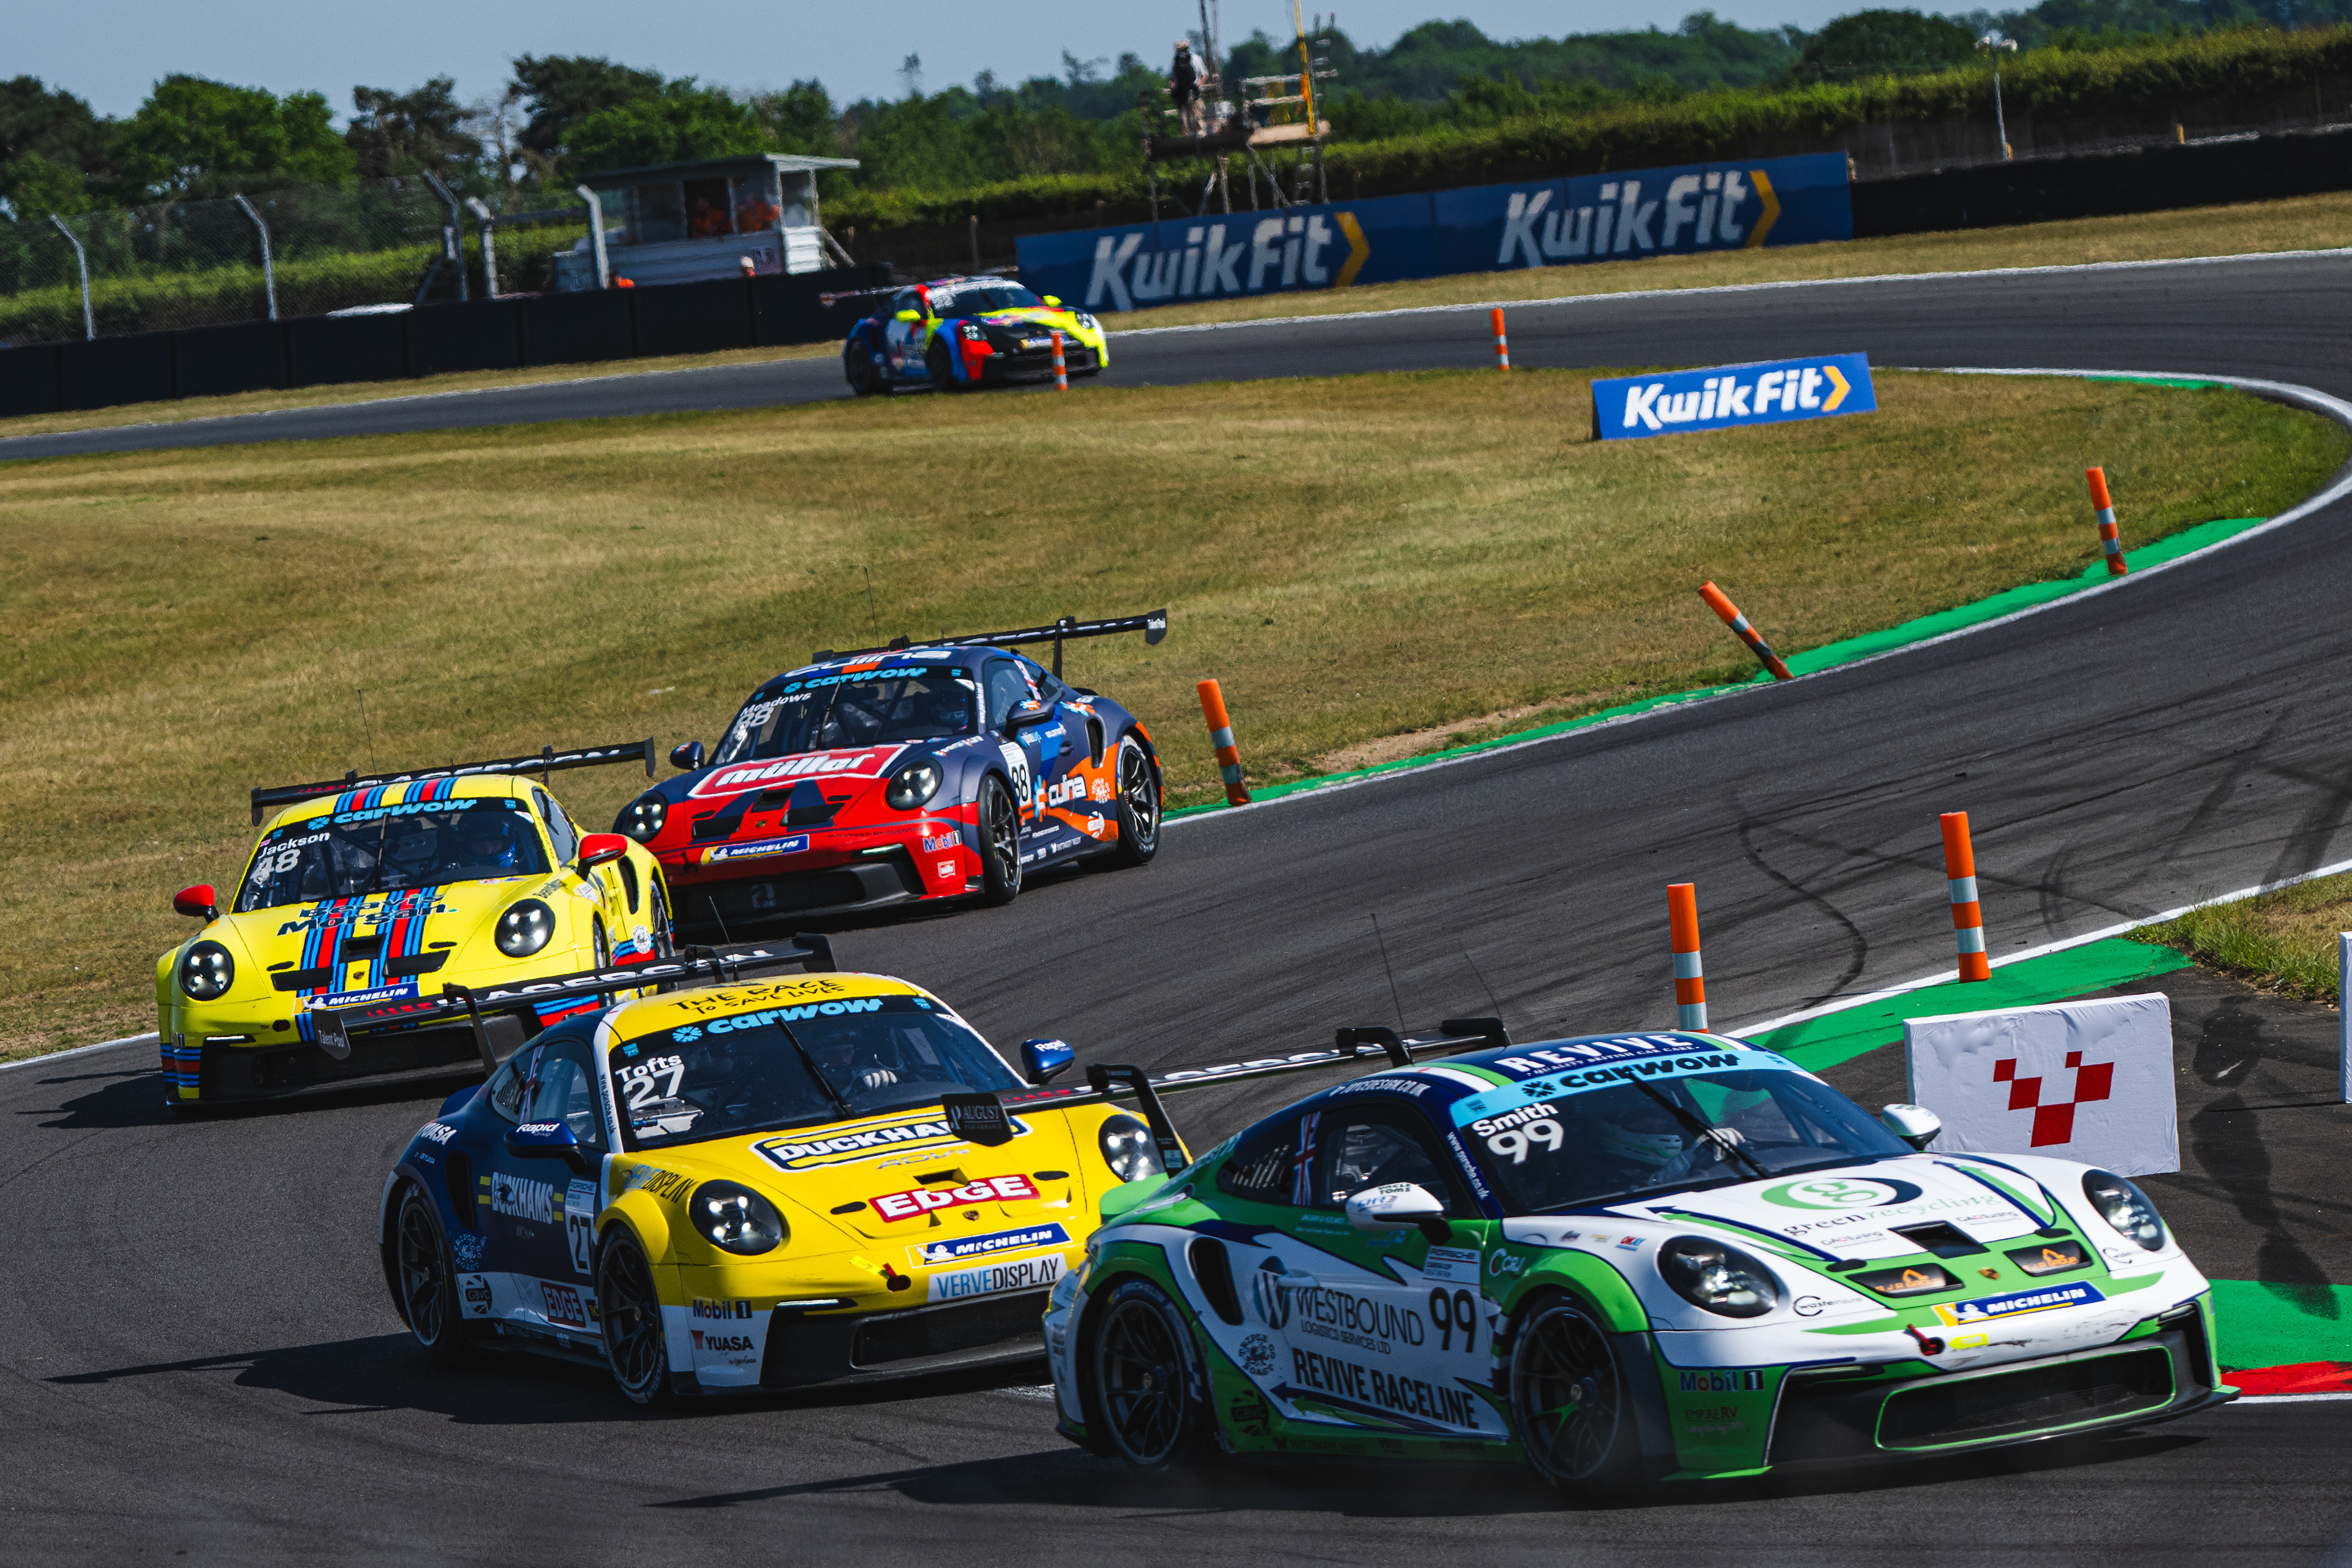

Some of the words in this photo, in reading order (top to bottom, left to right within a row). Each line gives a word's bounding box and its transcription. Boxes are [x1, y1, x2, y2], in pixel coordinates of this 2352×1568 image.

[804, 667, 927, 689] carwow
[740, 692, 812, 717] Meadows
[735, 706, 774, 733] 88
[715, 753, 876, 787] müller
[1049, 774, 1087, 807] culina
[333, 799, 477, 824] carwow
[257, 832, 331, 859] Jackson
[730, 840, 799, 856] MICHELIN
[250, 849, 301, 881] 48
[299, 894, 445, 918] Beavis
[328, 987, 409, 1005] MICHELIN
[668, 992, 737, 1010] THE
[747, 979, 833, 995] RACE
[725, 992, 783, 1007] SAVE
[787, 985, 846, 997] LIVES
[707, 998, 884, 1035] carwow
[318, 1030, 333, 1047] Talent
[333, 1035, 345, 1048] Pool
[1034, 1039, 1067, 1052] Rapid
[1494, 1035, 1694, 1073] REVIVE
[1534, 1060, 1585, 1074] QUALITY
[1586, 1052, 1635, 1063] BRITISH
[614, 1054, 683, 1082] Tofts
[1559, 1054, 1741, 1088] carwow
[623, 1063, 685, 1111] 27
[600, 1074, 617, 1136] www.porsche.co.uk
[962, 1105, 1000, 1120] AUGUST
[516, 1121, 560, 1134] Rapid
[1472, 1102, 1559, 1137] Smith
[771, 1121, 951, 1163] DUCKHA
[1487, 1118, 1564, 1166] 99
[491, 1171, 553, 1224] DUCKHAMS
[570, 1181, 594, 1191] PORSCHE
[876, 1176, 1033, 1218] EDGE
[570, 1215, 592, 1273] 27
[955, 1229, 1053, 1255] MICHELIN
[1430, 1248, 1477, 1259] PORSCHE
[468, 1289, 490, 1300] GBVC
[544, 1288, 584, 1322] EDGE
[1987, 1288, 2087, 1314] MICHELIN
[693, 1299, 732, 1319] Mobil
[1295, 1285, 1425, 1346] WESTBOUND
[1428, 1286, 1477, 1354] 99
[705, 1336, 755, 1351] YUASA
[1300, 1319, 1340, 1340] LOGISTICS
[1376, 1341, 1392, 1355] LTD
[1292, 1348, 1370, 1402] REVIVE
[1371, 1367, 1479, 1430] RACELINE
[1679, 1370, 1738, 1392] Mobil
[1235, 1406, 1267, 1420] GBVC
